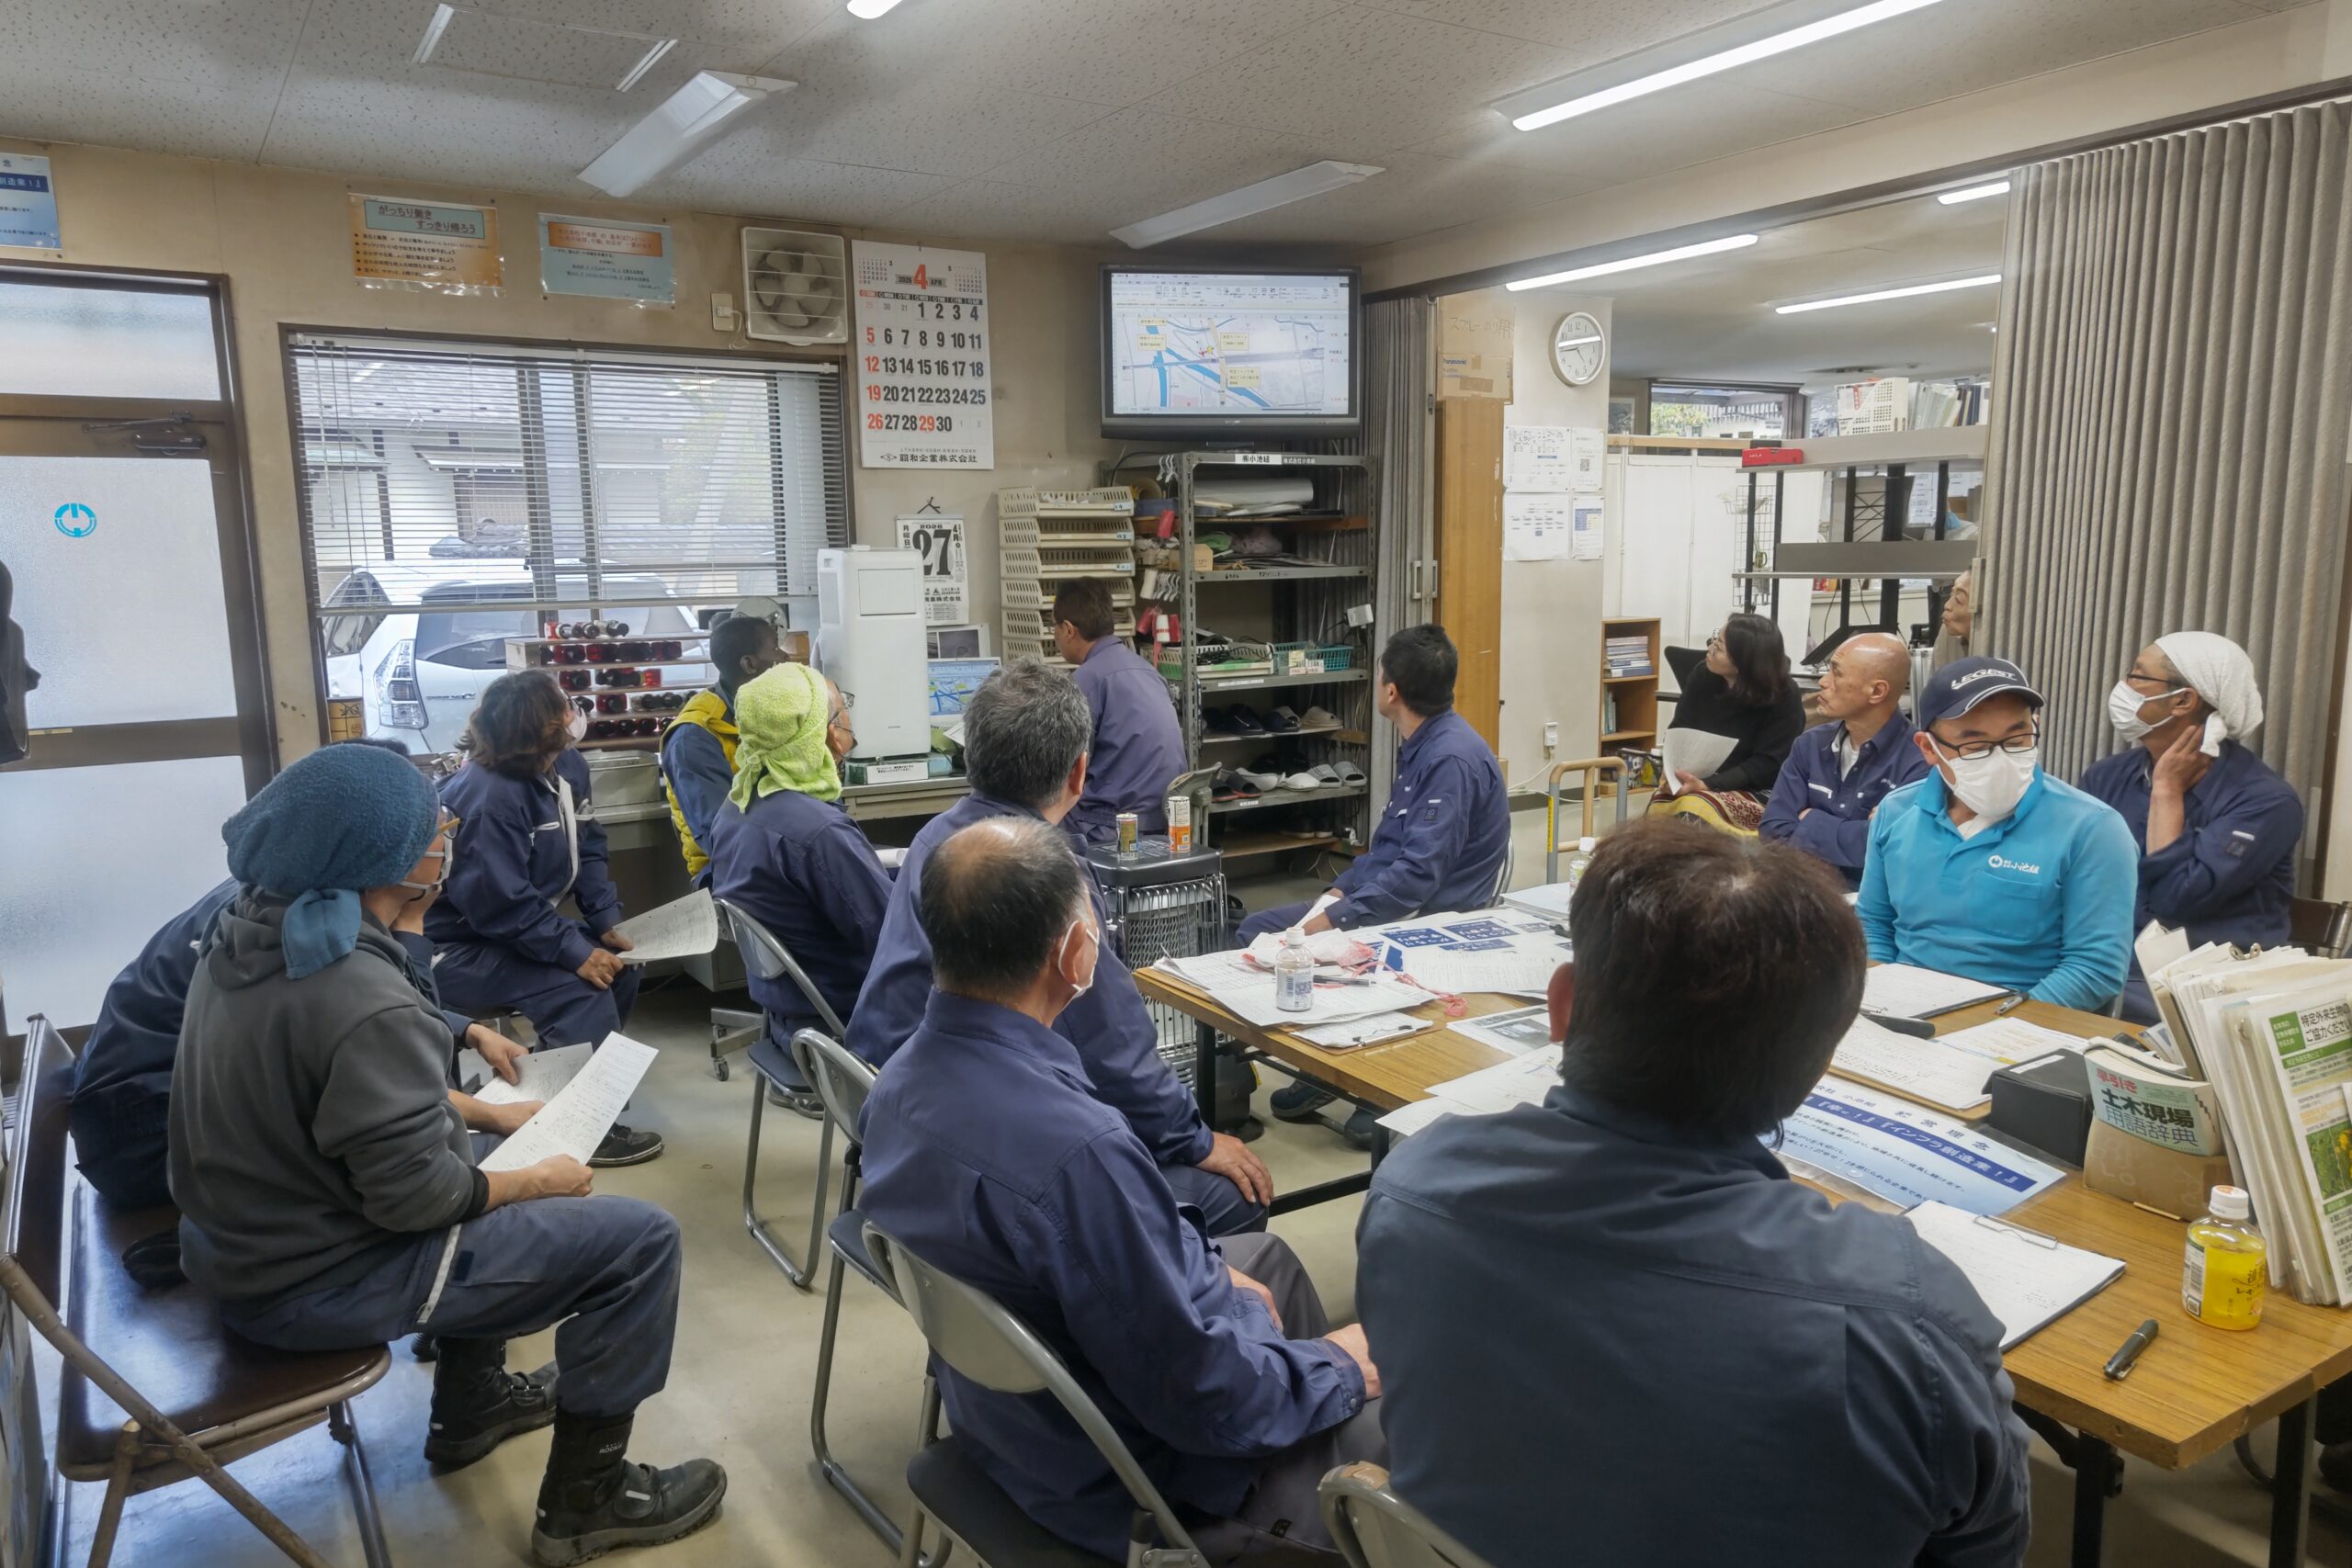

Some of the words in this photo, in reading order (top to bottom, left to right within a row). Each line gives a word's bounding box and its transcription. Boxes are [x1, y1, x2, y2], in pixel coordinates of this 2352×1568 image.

[913, 264, 927, 290] 4
[918, 302, 925, 319] 1
[935, 303, 944, 319] 2
[952, 305, 961, 321] 3
[969, 306, 978, 321] 4
[867, 327, 875, 344] 5
[884, 328, 893, 344] 6
[901, 330, 910, 345] 7
[919, 331, 928, 346] 8
[936, 332, 945, 347] 9
[951, 333, 966, 349] 10
[968, 333, 982, 349] 11
[865, 355, 879, 372] 12
[882, 357, 897, 373] 13
[899, 358, 914, 375] 14
[917, 359, 933, 375] 15
[934, 360, 949, 376] 16
[952, 361, 966, 377] 17
[968, 362, 984, 378] 18
[867, 385, 881, 400] 19
[883, 386, 899, 402] 20
[900, 387, 916, 402] 21
[918, 387, 934, 403] 22
[934, 388, 951, 404] 23
[952, 389, 968, 404] 24
[969, 389, 986, 405] 25
[867, 413, 884, 430] 26
[885, 414, 900, 431] 27
[901, 414, 918, 431] 28
[919, 415, 935, 432] 29
[935, 416, 952, 432] 30
[899, 454, 978, 463] 昭和企業株式会社
[903, 525, 911, 547] 月曜日
[912, 529, 952, 576] 27
[1951, 668, 2017, 690] LEGEST
[2097, 1067, 2138, 1094] 早引き
[2101, 1088, 2195, 1129] 土木現場
[2105, 1105, 2199, 1147] 用語辞典
